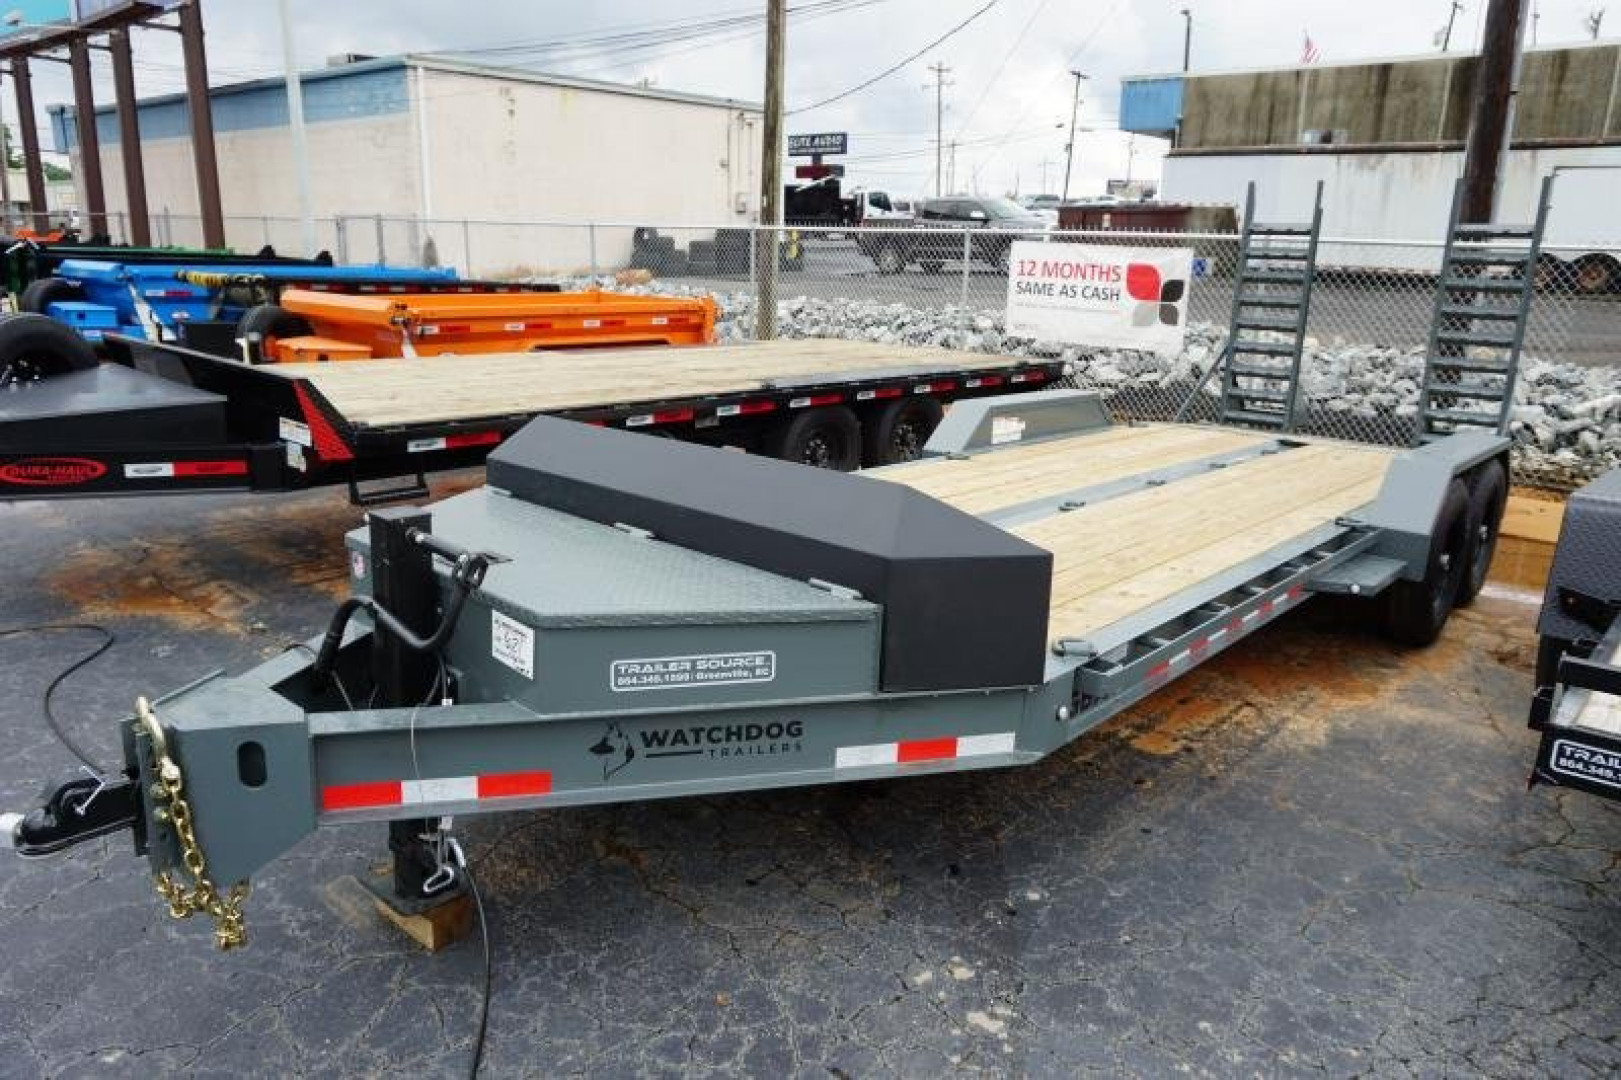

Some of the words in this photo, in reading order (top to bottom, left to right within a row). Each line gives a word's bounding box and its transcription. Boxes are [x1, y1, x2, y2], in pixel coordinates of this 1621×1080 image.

[1017, 260, 1037, 277] 12
[1041, 261, 1122, 283] MONTHS
[1016, 281, 1055, 297] SAME
[1060, 284, 1077, 299] AS
[1081, 286, 1121, 301] CASH
[617, 661, 692, 675] TRAILER
[696, 656, 765, 670] SOURCE
[640, 720, 803, 748] WATCHDOG
[709, 742, 802, 760] TRAILERS
